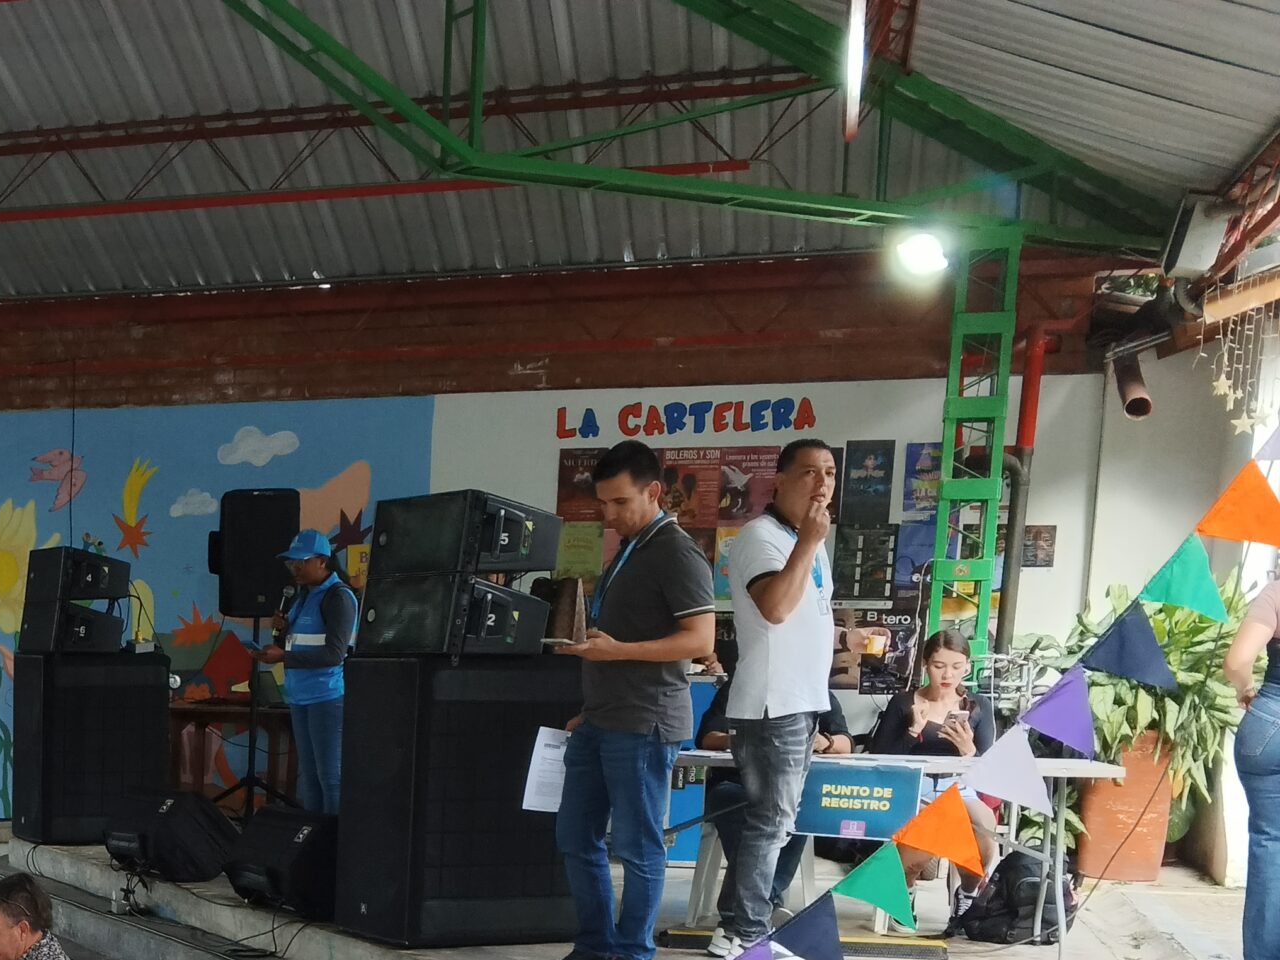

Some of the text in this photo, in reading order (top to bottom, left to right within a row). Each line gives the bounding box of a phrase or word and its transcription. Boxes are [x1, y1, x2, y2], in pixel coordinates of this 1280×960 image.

[556, 397, 817, 439] LA CARTELERA
[665, 449, 720, 460] BOLEROS Y SON
[500, 533, 509, 545] 5
[86, 573, 92, 582] 4
[487, 613, 496, 626] 2
[822, 784, 893, 798] PUNTO DE
[821, 796, 891, 811] REGISTRO
